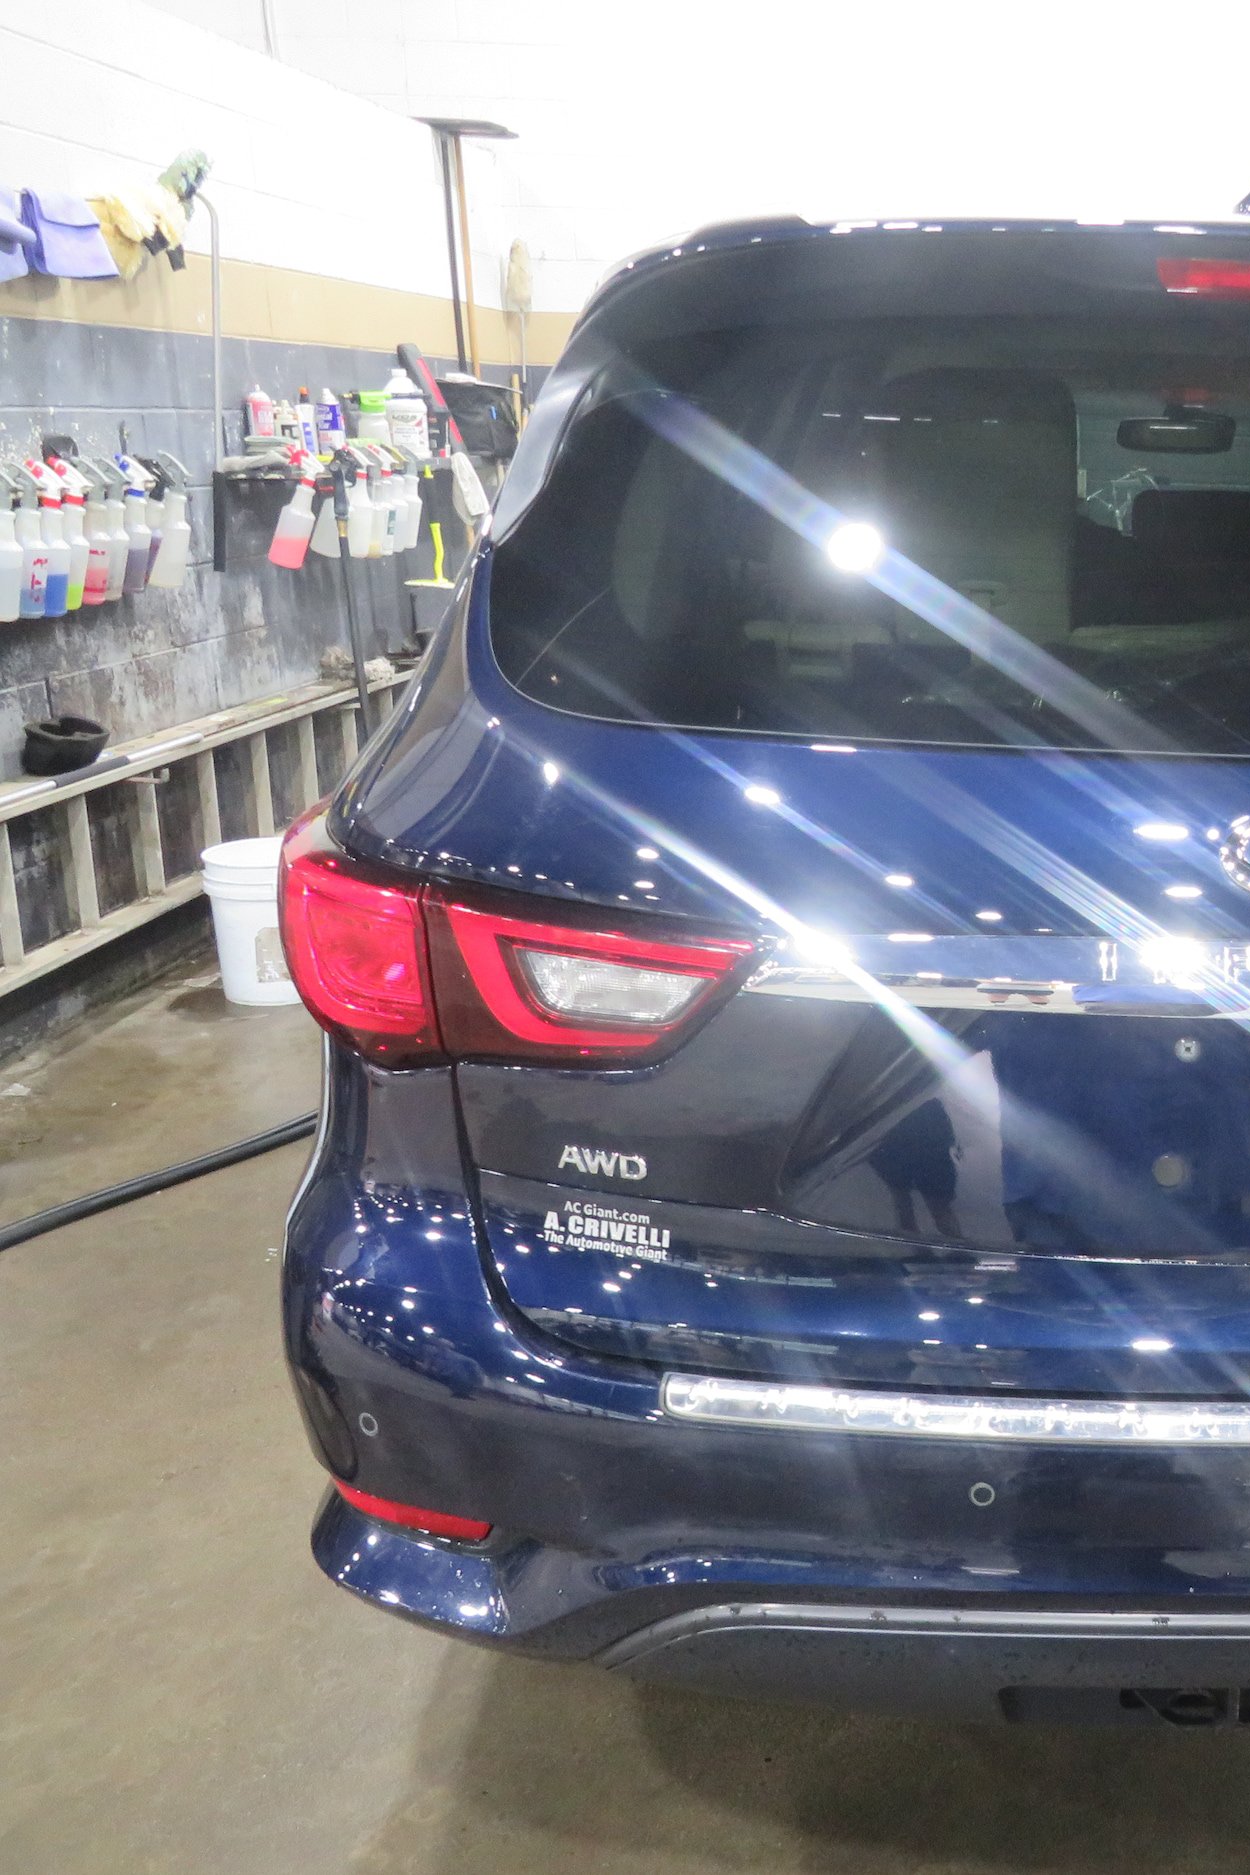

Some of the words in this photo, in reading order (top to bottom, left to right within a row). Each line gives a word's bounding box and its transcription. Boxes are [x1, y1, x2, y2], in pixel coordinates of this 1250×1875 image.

[558, 1144, 648, 1181] AWD
[543, 1211, 566, 1232] A.
[568, 1215, 671, 1248] CRIVELLI
[544, 1230, 565, 1244] The
[566, 1234, 633, 1256] Automotive
[635, 1246, 668, 1261] Giant
